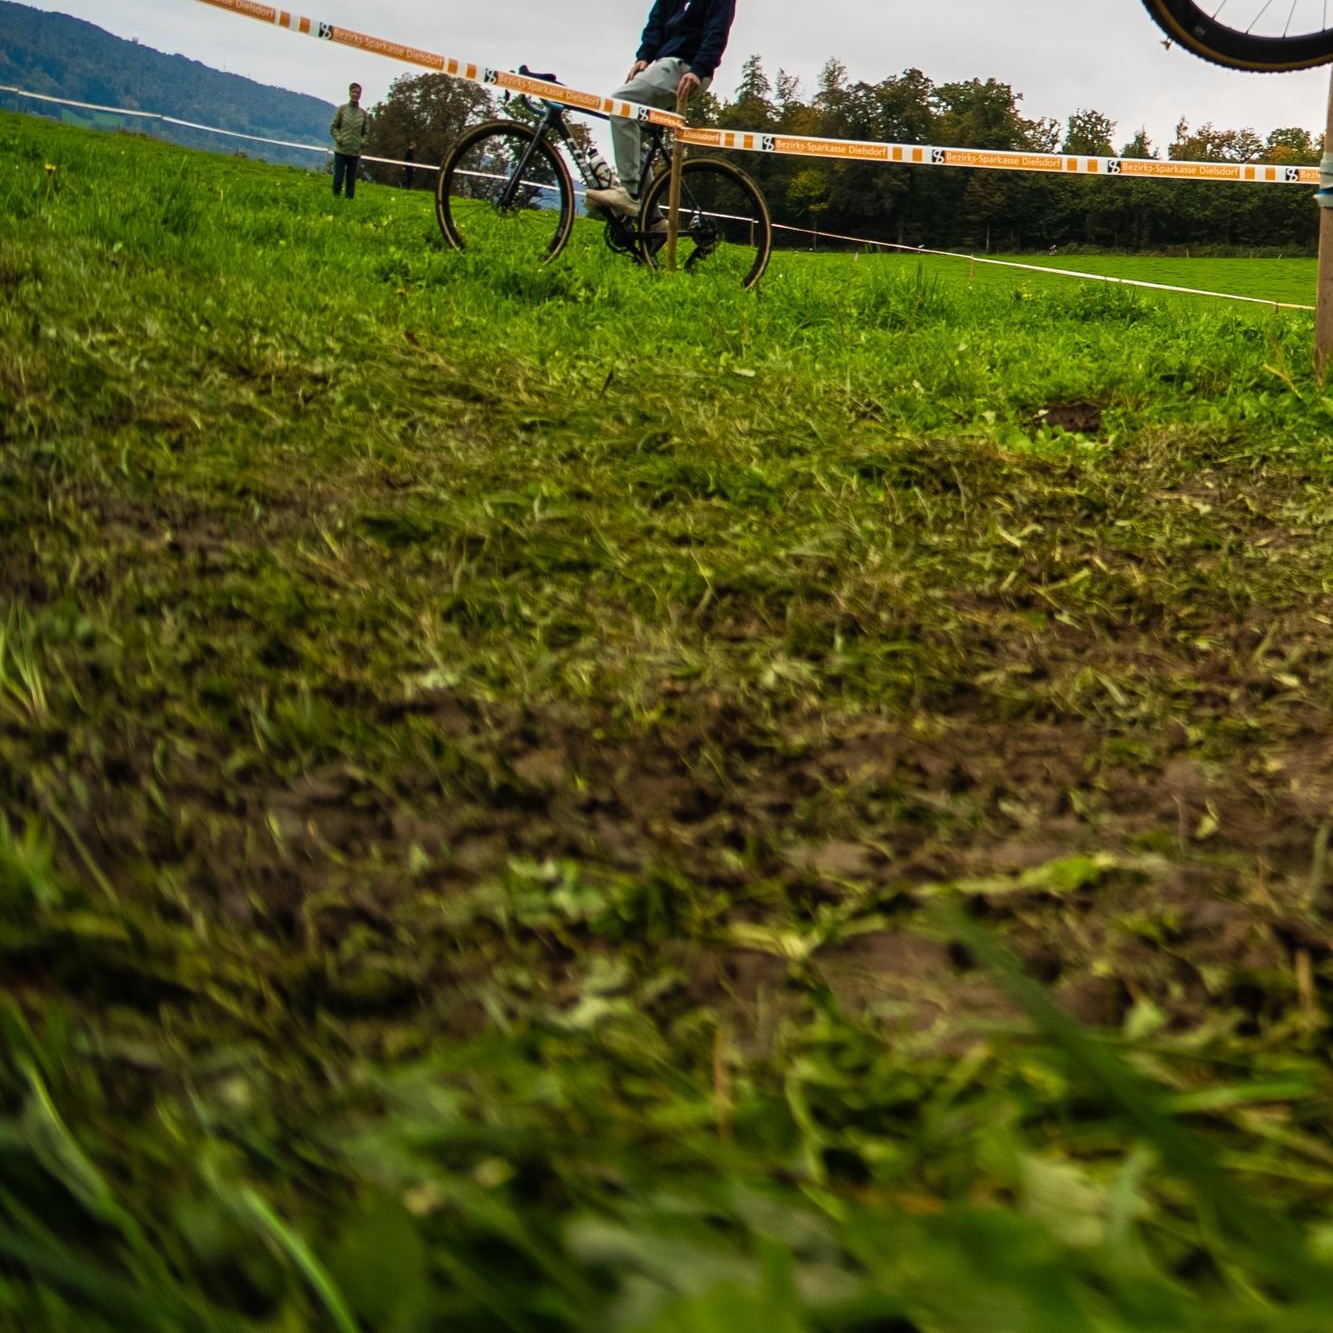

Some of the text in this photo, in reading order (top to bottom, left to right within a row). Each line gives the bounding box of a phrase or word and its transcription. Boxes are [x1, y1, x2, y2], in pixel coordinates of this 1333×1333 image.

[333, 28, 443, 67] Bezirks-Sparkasse Dielsdorf
[498, 73, 600, 107] Bezirks-Sparkasse Dielsdorf
[775, 139, 887, 157] Bezirks-Sparkasse Dielsdorf
[946, 152, 1061, 168] Bezirks-Sparkasse Dielsdorf
[1123, 163, 1238, 176] Bezirks-Sparkasse Dielsdorf
